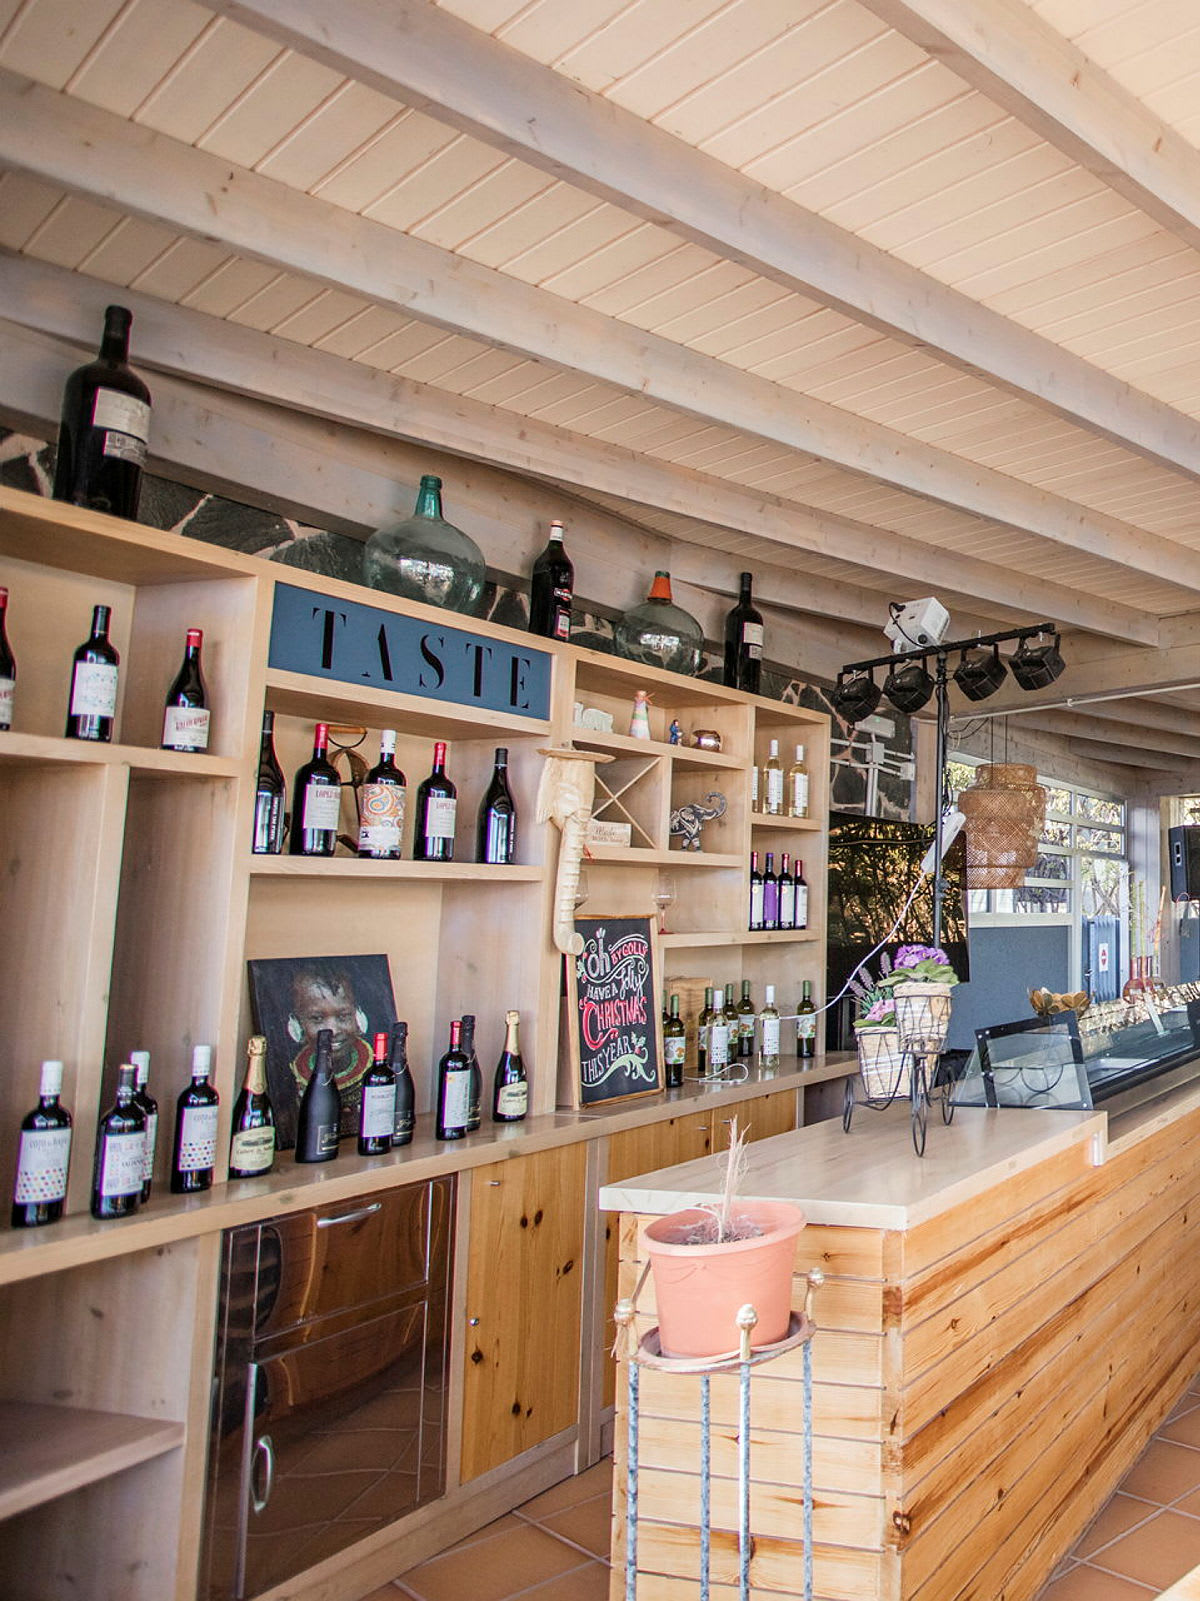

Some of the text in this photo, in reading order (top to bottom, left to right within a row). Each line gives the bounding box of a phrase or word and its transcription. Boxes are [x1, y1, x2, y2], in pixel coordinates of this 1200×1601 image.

[312, 607, 531, 709] TASTE
[611, 948, 622, 965] BY
[587, 983, 611, 1000] HAVE
[611, 982, 619, 996] A
[580, 996, 648, 1051] CHRISTMAS
[581, 1035, 634, 1083] THIS YEAR
